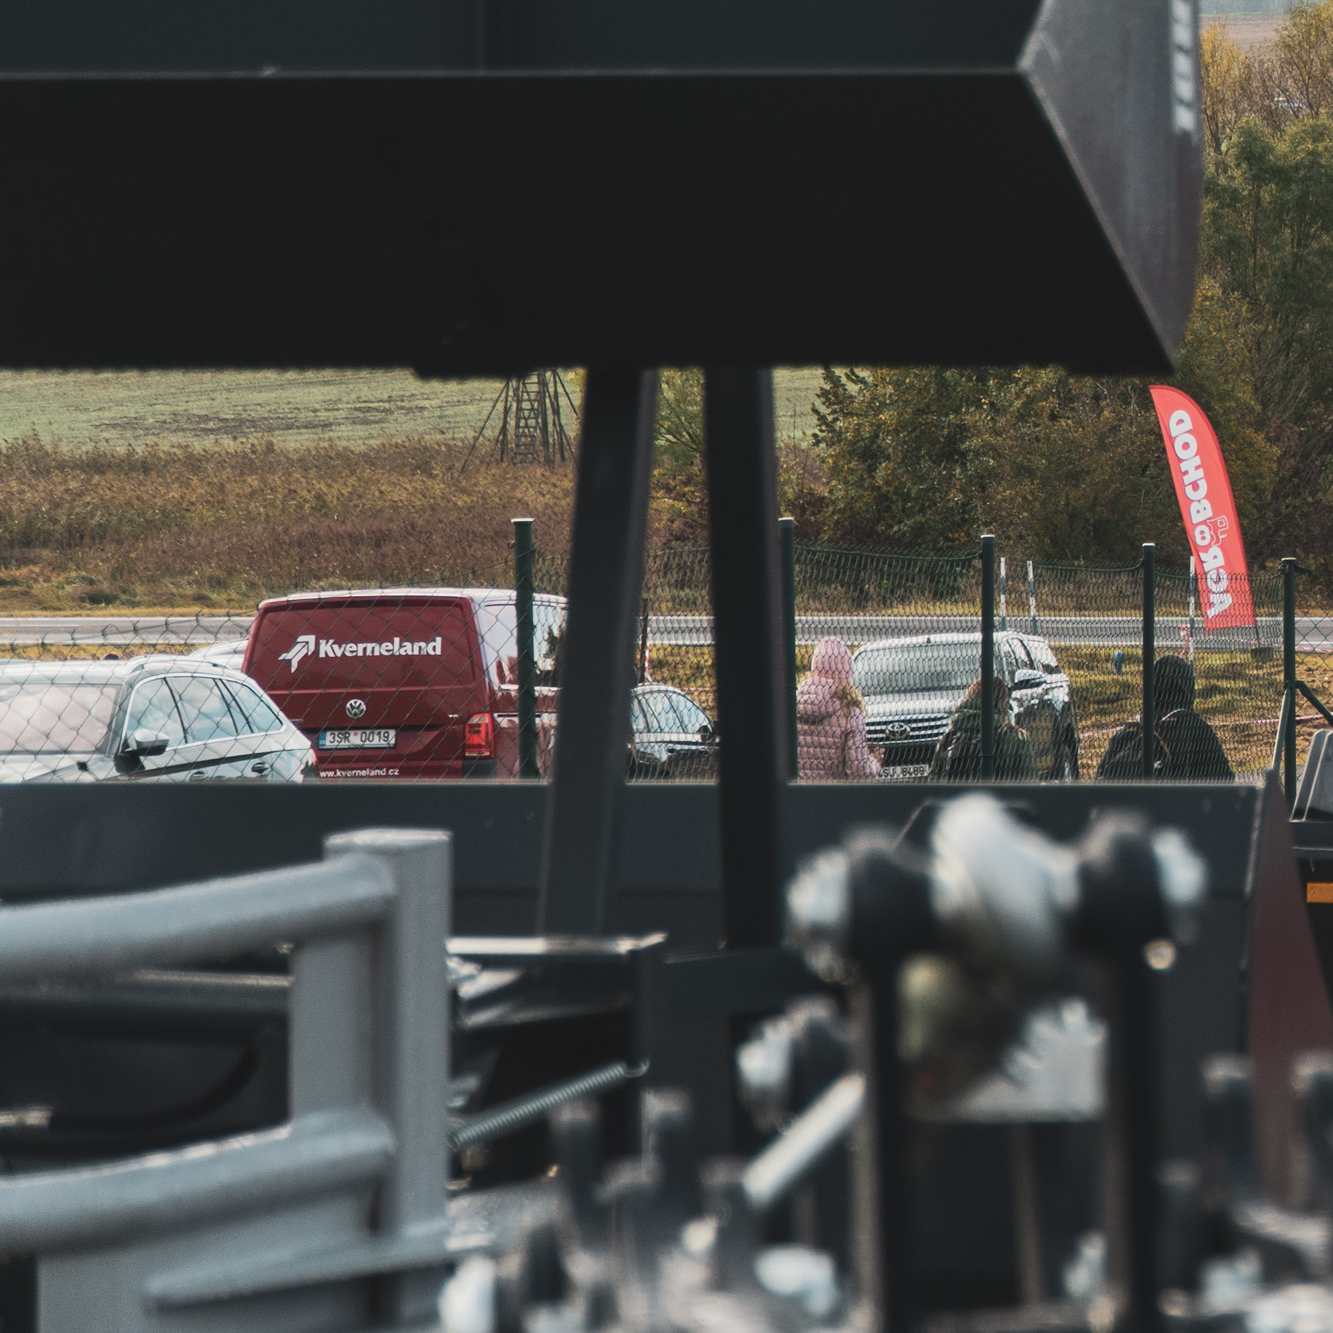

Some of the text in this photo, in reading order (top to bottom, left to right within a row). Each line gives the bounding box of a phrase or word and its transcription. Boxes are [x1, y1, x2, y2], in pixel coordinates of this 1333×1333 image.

[319, 637, 442, 658] Kverneland
[328, 730, 391, 745] 3SR 0019
[319, 768, 399, 777] ww.kverneland.cz
